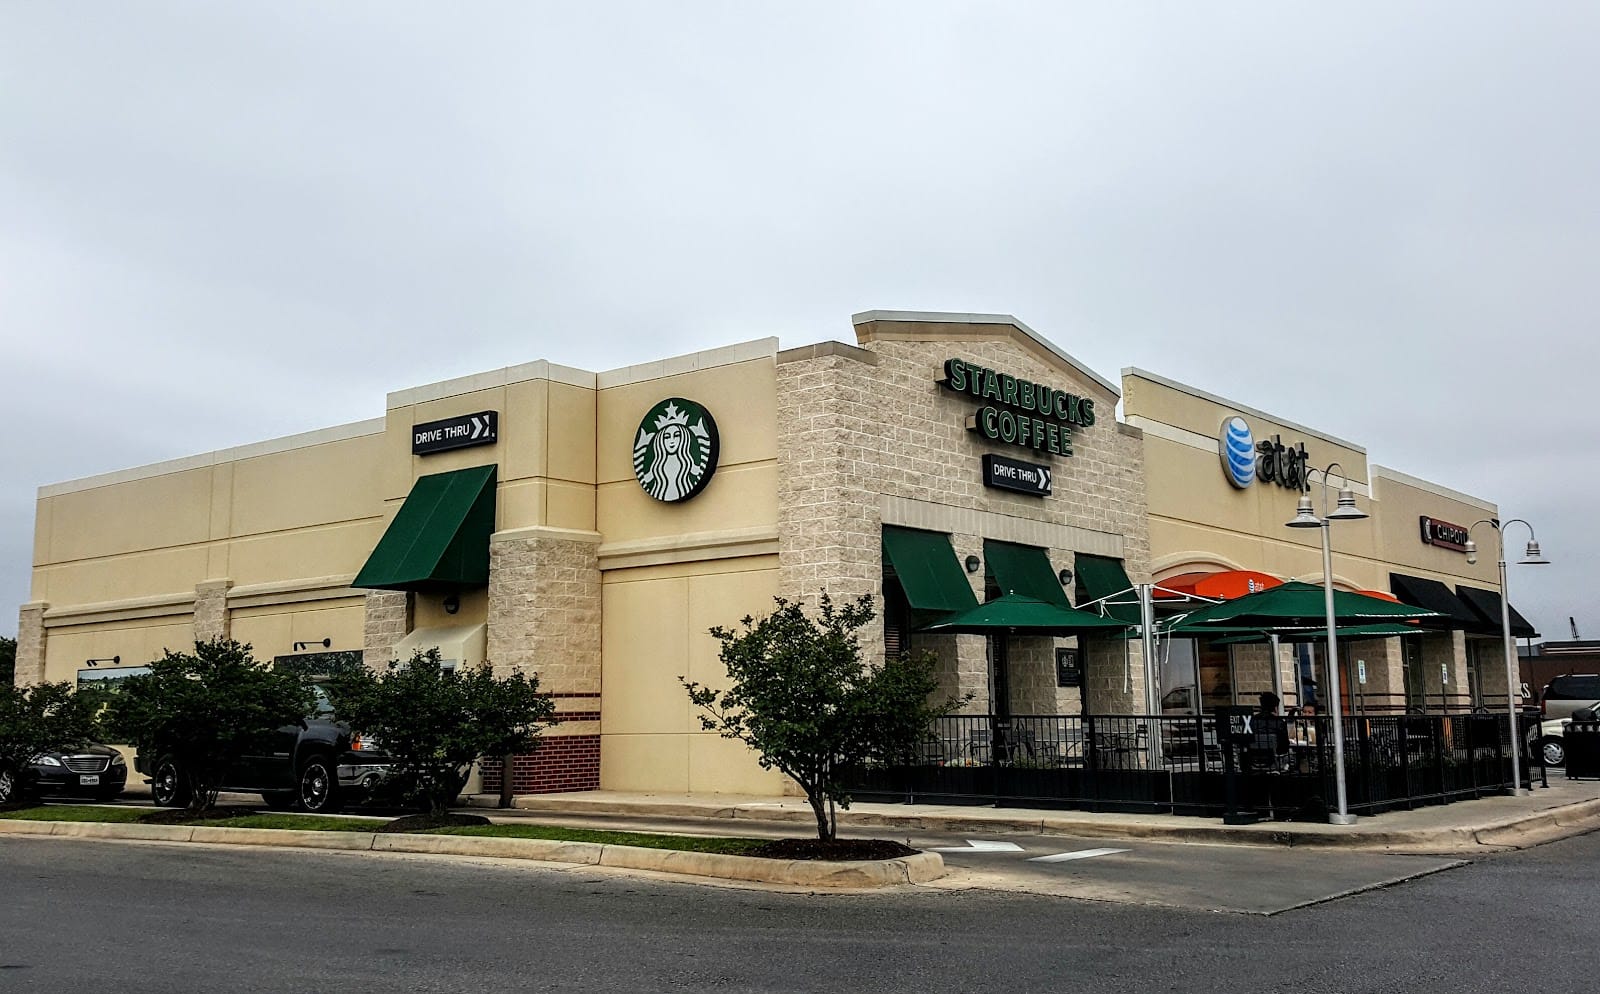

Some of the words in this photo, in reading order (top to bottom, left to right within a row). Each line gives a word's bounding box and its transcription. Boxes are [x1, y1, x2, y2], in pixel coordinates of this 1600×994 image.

[945, 358, 1096, 428] STARBUCKS
[415, 429, 442, 445] DRIVE
[444, 423, 470, 439] THRU
[977, 407, 1073, 457] COFFEE
[993, 463, 1017, 479] DRIVE
[1017, 468, 1038, 483] THRU
